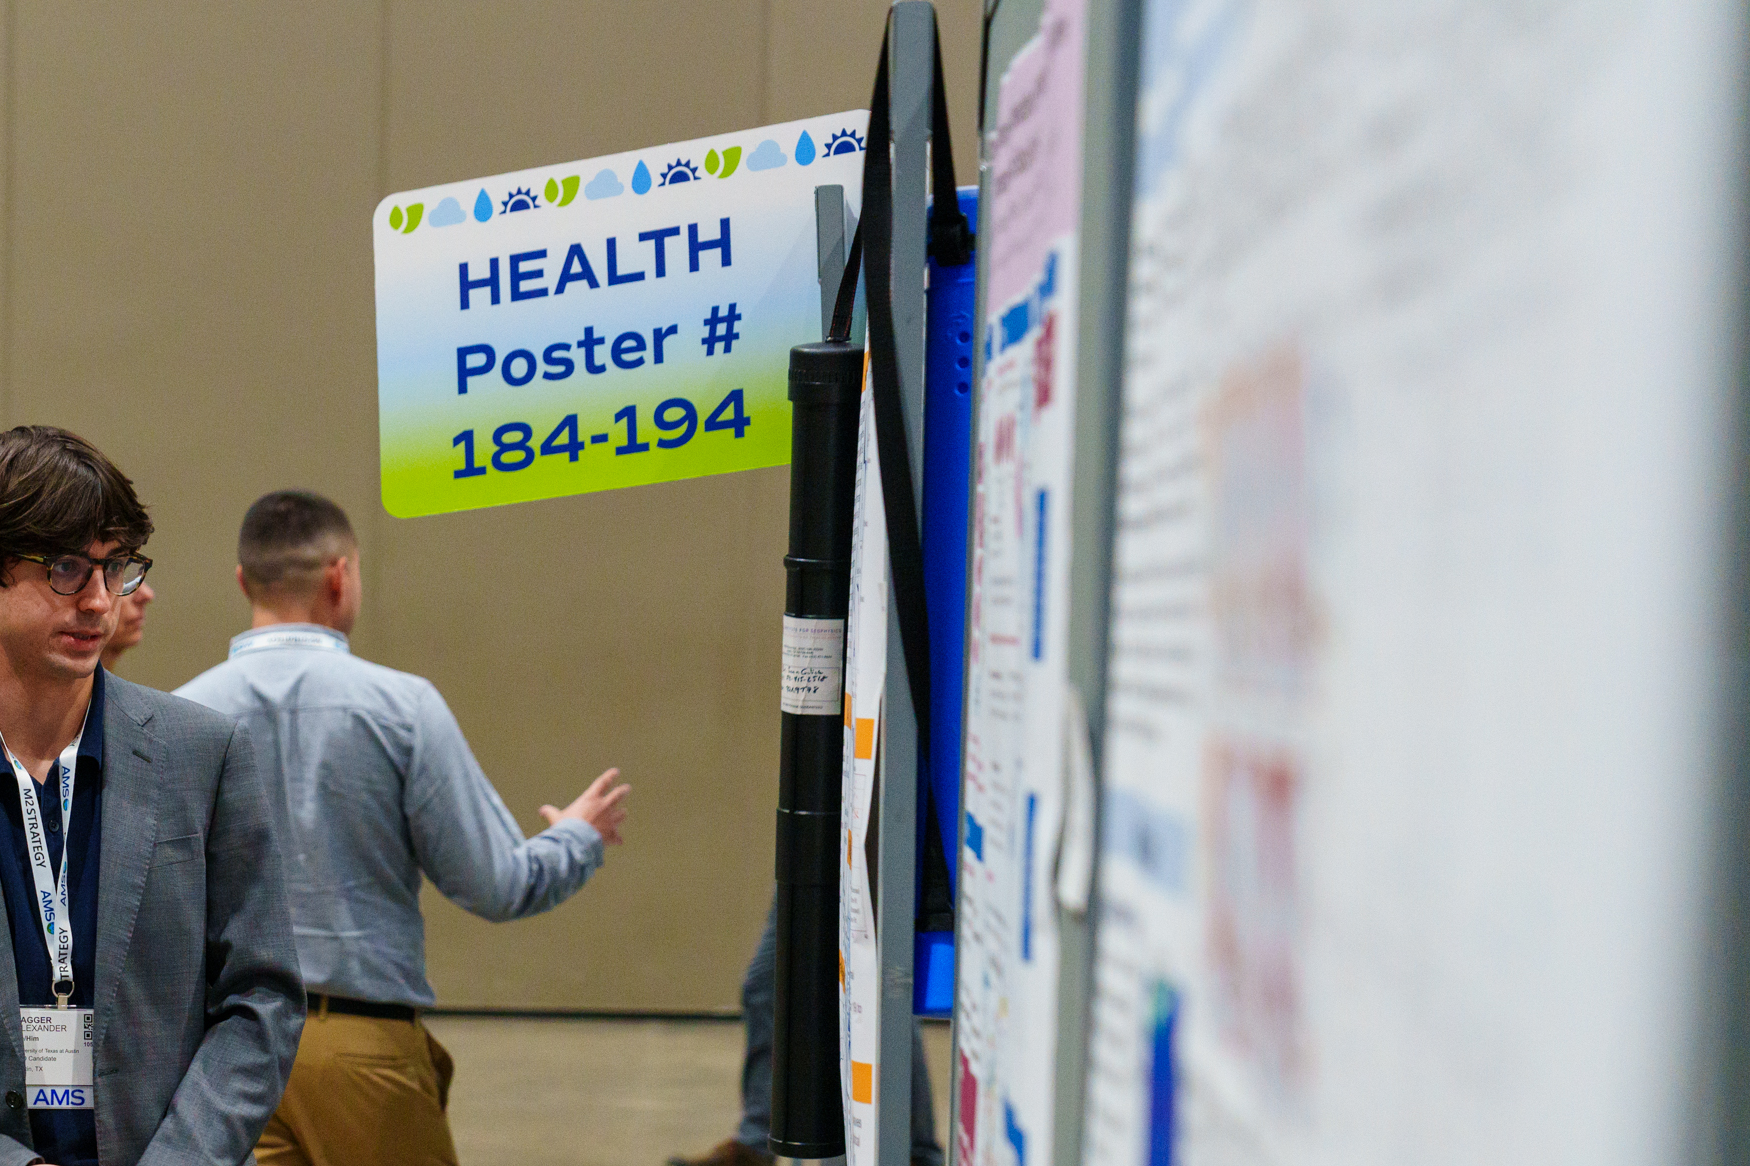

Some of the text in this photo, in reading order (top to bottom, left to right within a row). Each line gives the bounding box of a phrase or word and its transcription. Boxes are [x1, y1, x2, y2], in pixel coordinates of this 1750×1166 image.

[458, 217, 733, 311] HEALTH
[456, 302, 742, 396] Poster #
[451, 388, 752, 480] 184-194
[61, 766, 71, 798] AMS
[40, 889, 56, 922] AMS
[33, 1088, 86, 1106] AMS
